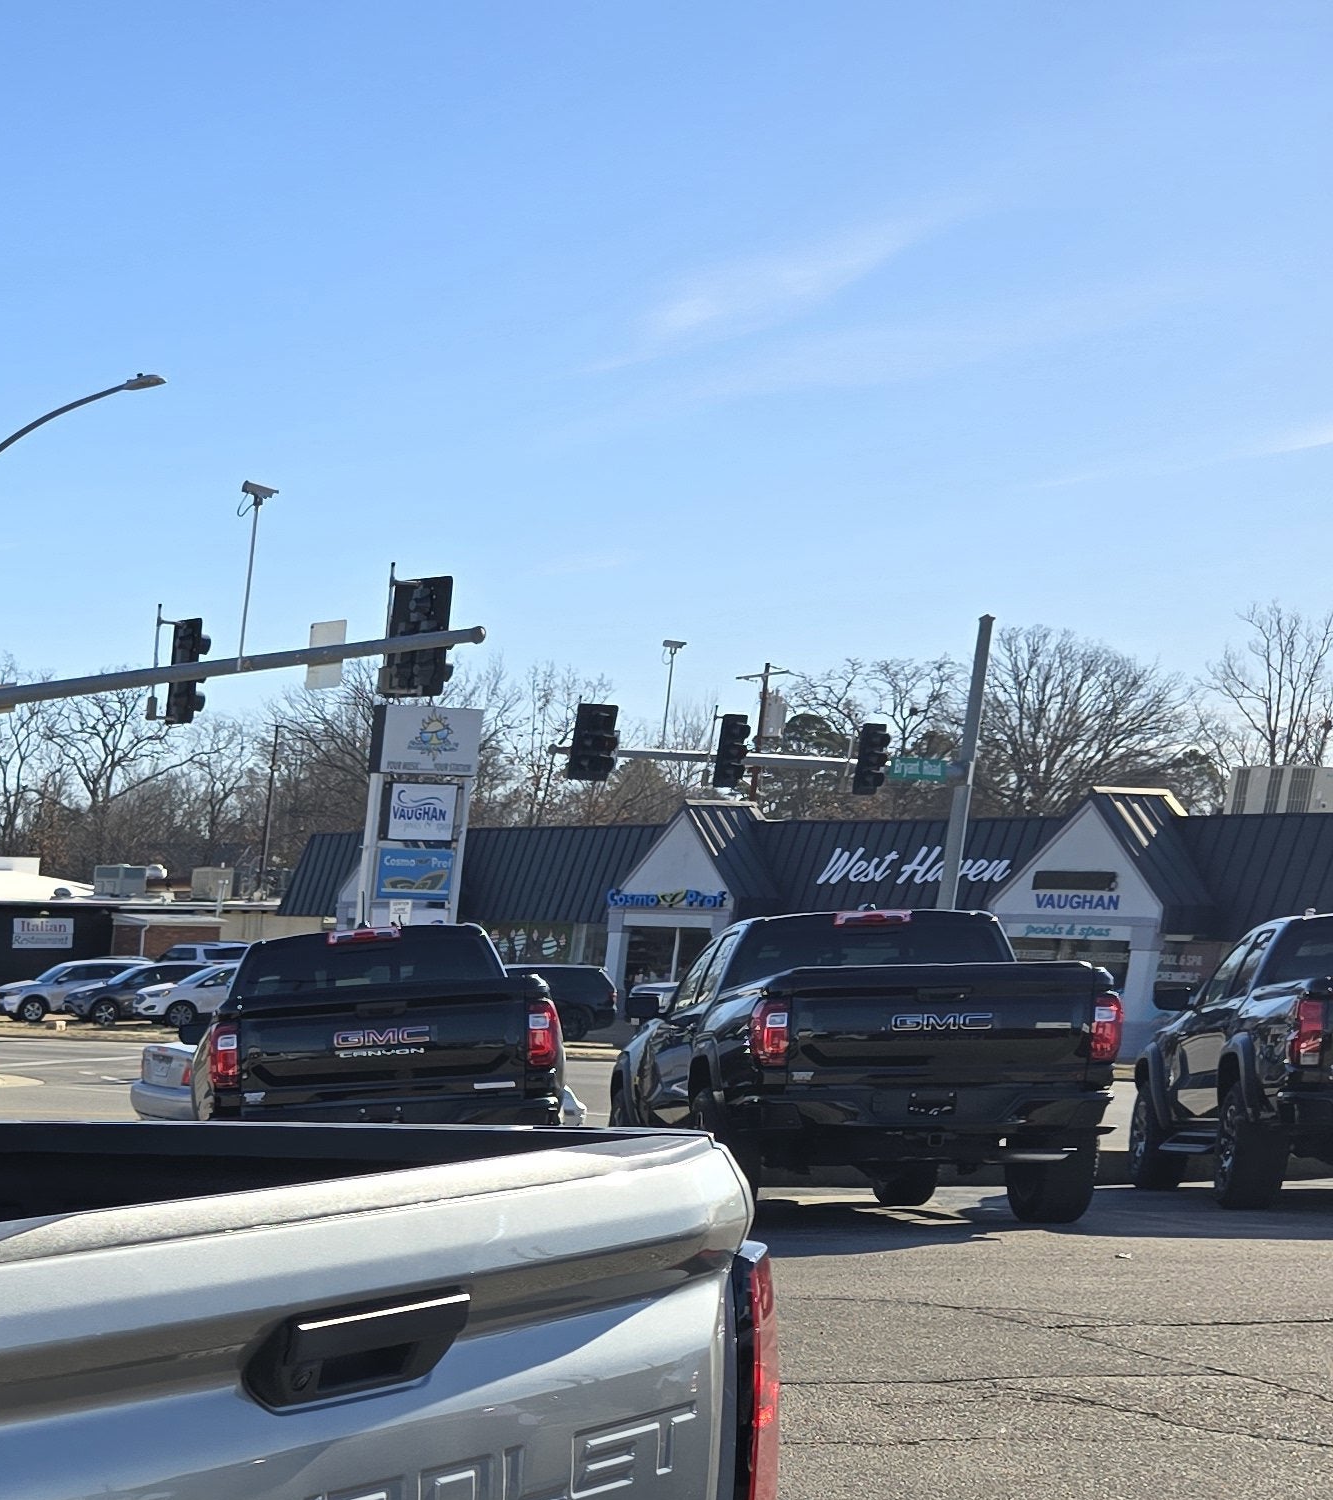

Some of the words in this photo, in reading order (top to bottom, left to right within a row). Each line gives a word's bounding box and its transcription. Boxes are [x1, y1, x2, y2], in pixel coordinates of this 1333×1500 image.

[392, 805, 447, 821] VAUGHAN
[384, 855, 416, 867] Cosmo
[816, 846, 900, 885] West
[607, 888, 659, 907] Cosmo
[686, 889, 727, 908] Prof
[1035, 893, 1121, 911] VAUGHAN
[20, 920, 67, 933] Italian
[1024, 923, 1063, 937] pools
[1065, 923, 1076, 936] &
[1079, 925, 1112, 939] spas
[12, 935, 69, 945] Restaurant
[891, 1012, 993, 1032] GMC
[334, 1025, 430, 1048] GMC
[338, 1047, 425, 1058] CANYON
